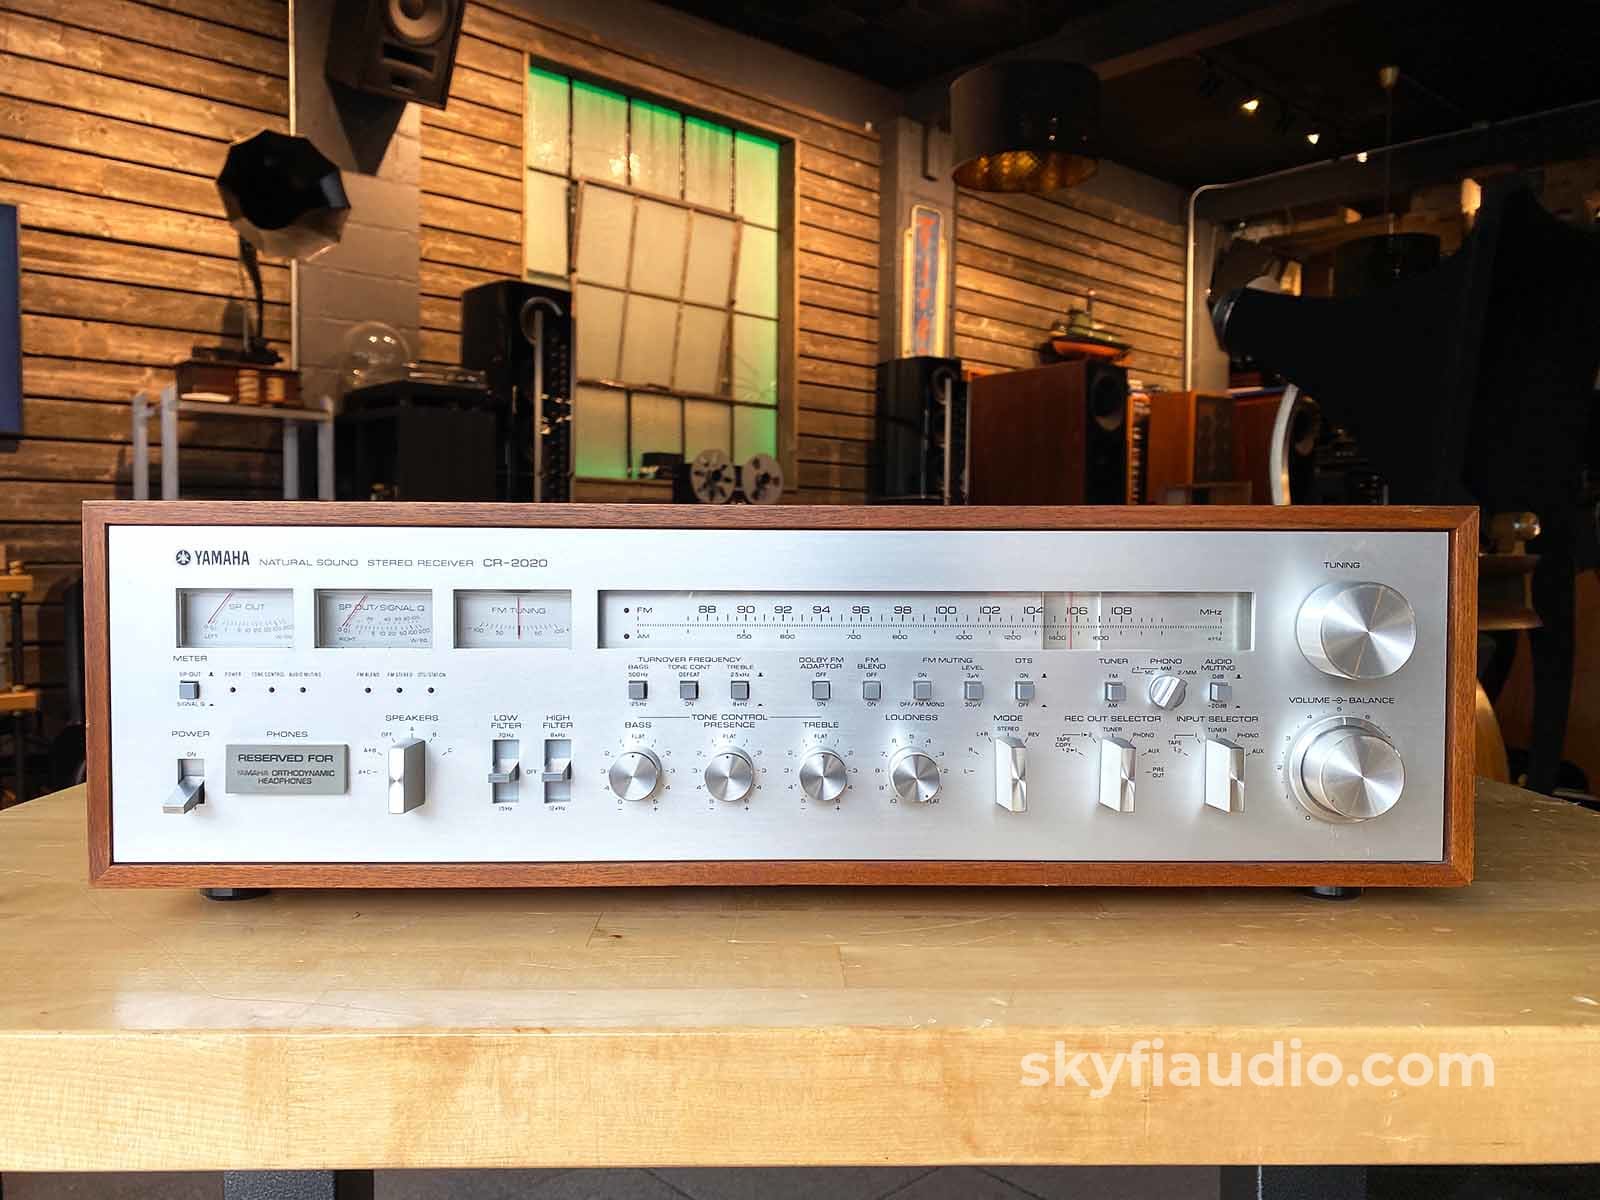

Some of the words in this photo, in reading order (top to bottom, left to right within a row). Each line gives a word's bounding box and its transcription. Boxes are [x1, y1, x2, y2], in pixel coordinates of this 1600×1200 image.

[194, 550, 250, 566] YAMAHA
[259, 559, 312, 567] NATURAL
[316, 559, 359, 567] SOUND
[367, 559, 413, 567] STEREO
[417, 559, 474, 567] RECEIVER
[483, 558, 548, 567] CR-2020
[698, 605, 717, 614] 88
[736, 605, 756, 614] 90
[774, 605, 792, 614] 92
[812, 606, 831, 614] 94
[852, 606, 870, 614] 96
[893, 606, 912, 614] 98
[935, 606, 957, 614] 100
[979, 606, 1001, 615] 102
[1023, 606, 1044, 615] 104
[1066, 607, 1088, 615] 106
[1111, 607, 1133, 615] 108
[385, 714, 439, 722] SPEAKERS
[238, 754, 304, 763] RESERVED
[308, 754, 334, 763] FOR
[258, 777, 312, 785] HEADPHONES
